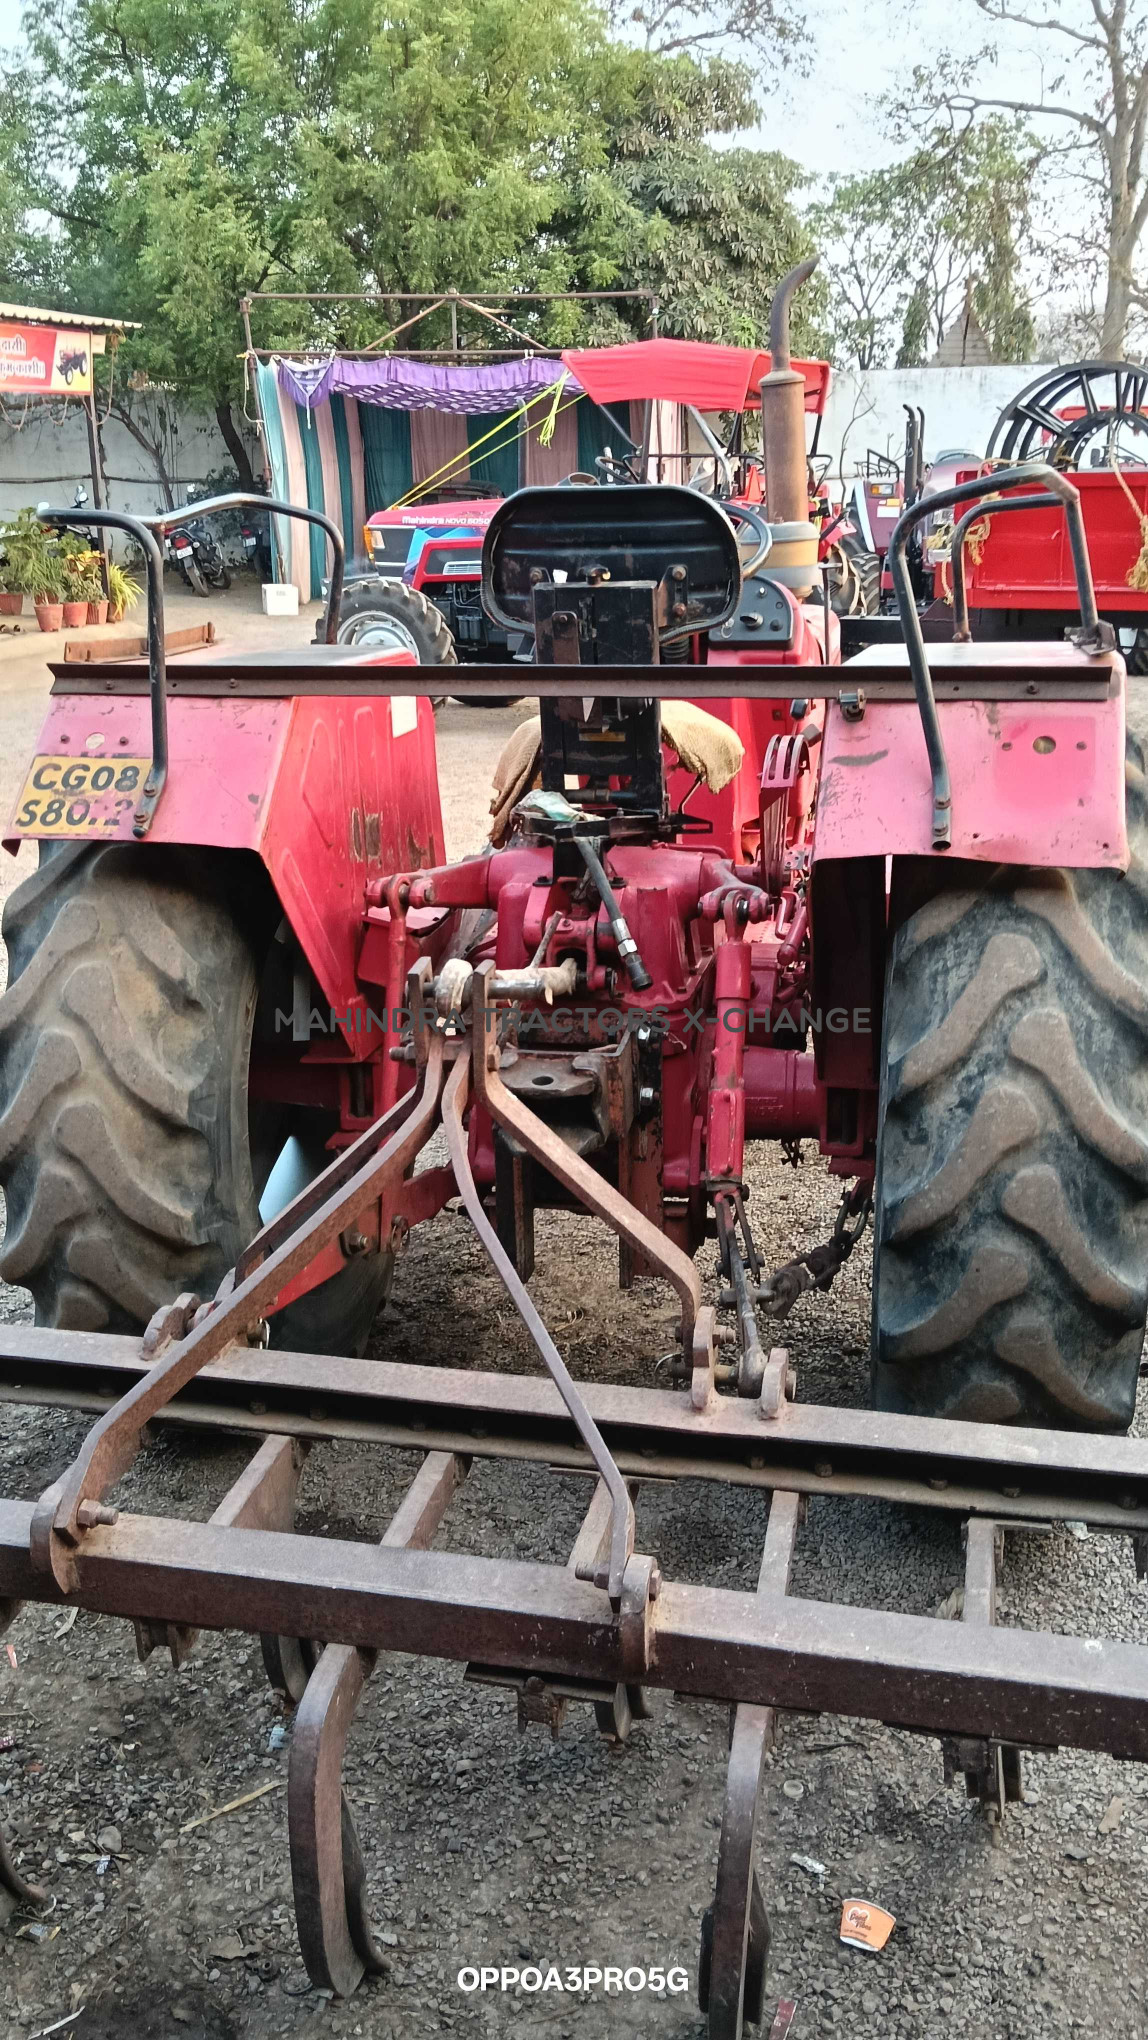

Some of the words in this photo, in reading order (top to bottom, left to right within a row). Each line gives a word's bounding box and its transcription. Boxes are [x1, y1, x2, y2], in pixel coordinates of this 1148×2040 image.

[402, 516, 444, 525] Mahindra
[445, 517, 466, 525] NOVO
[32, 763, 140, 792] CG08
[15, 799, 134, 827] S802
